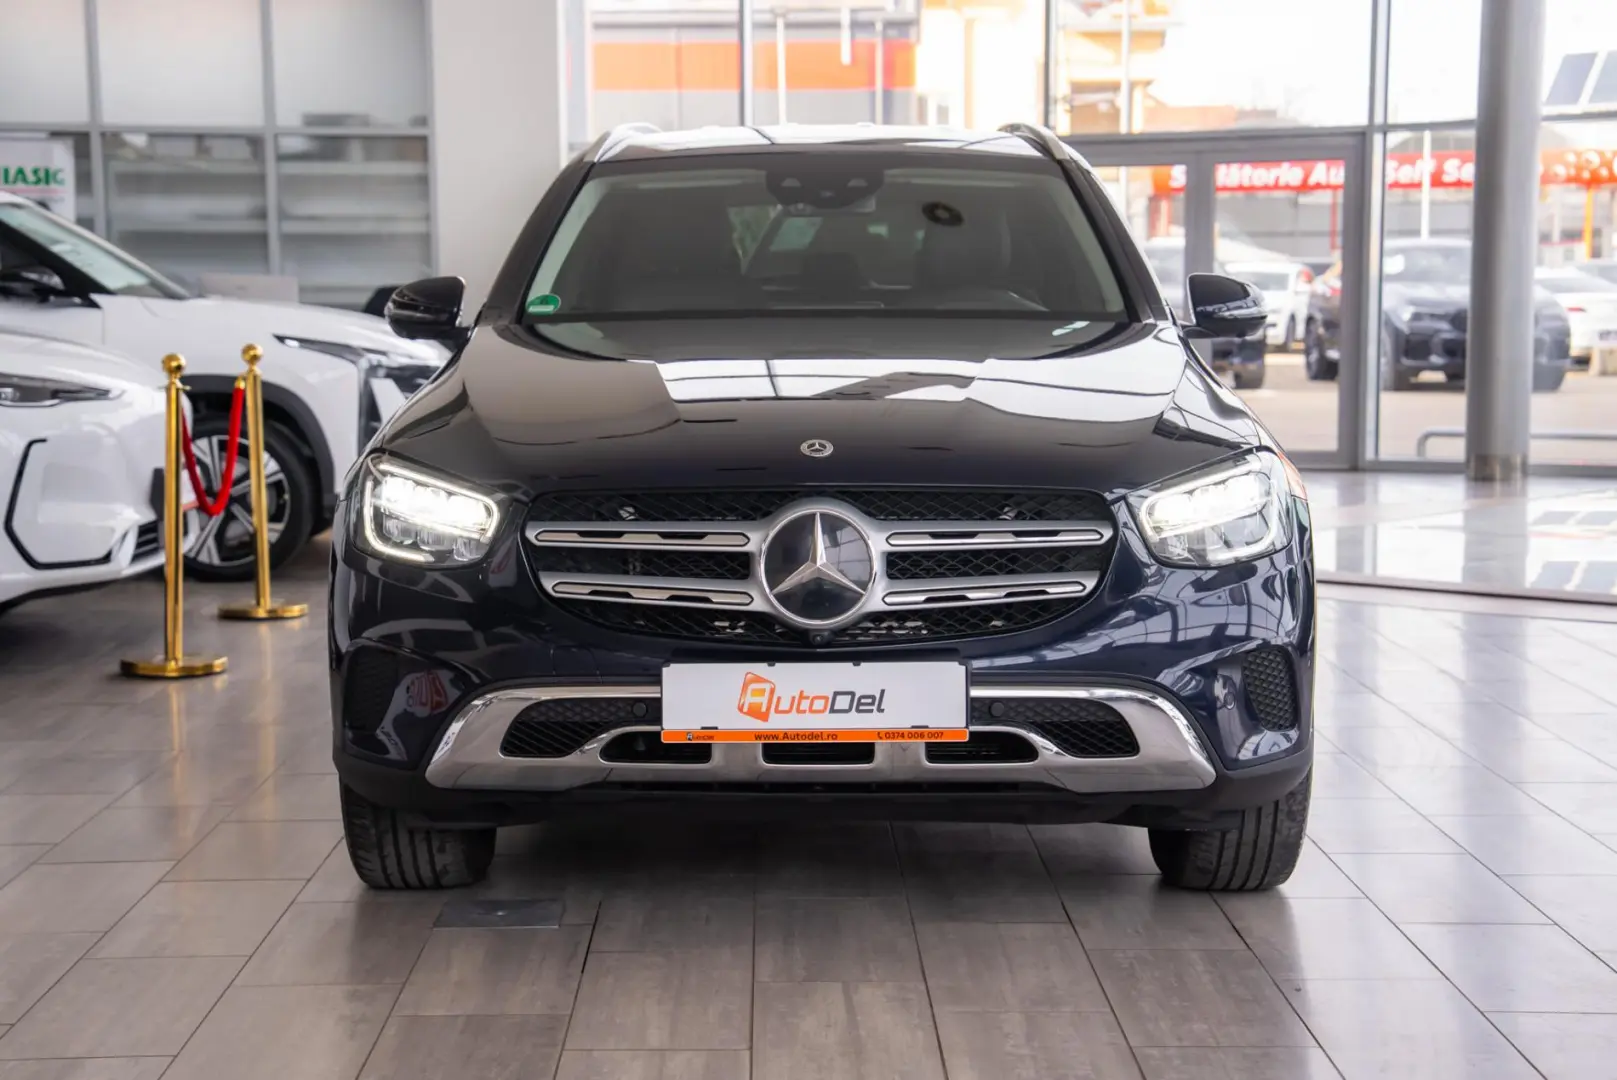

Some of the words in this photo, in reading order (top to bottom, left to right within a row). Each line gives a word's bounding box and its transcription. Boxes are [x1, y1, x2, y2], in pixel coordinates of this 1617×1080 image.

[1307, 161, 1345, 186] Au
[741, 679, 886, 716] AutoDel
[754, 731, 838, 741] www.Autodel.ro
[884, 732, 905, 740] 0374
[907, 732, 925, 740] 006
[927, 732, 944, 740] 007
